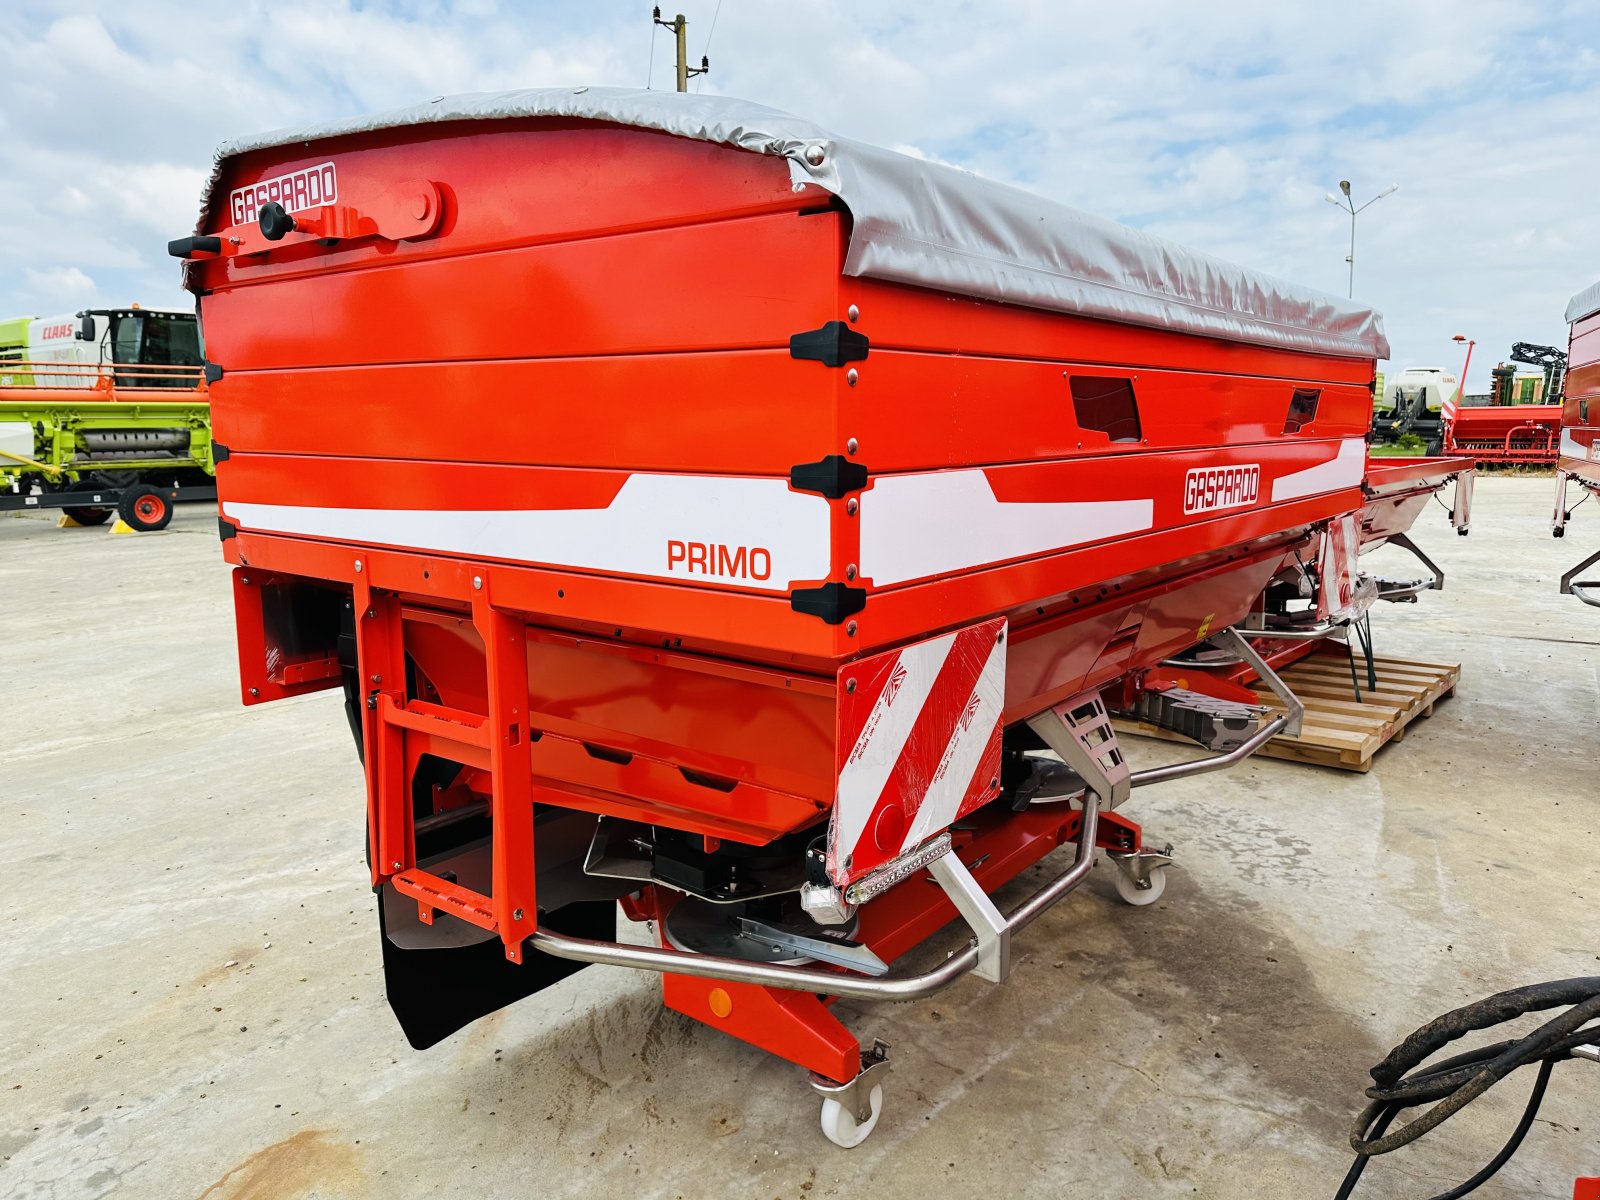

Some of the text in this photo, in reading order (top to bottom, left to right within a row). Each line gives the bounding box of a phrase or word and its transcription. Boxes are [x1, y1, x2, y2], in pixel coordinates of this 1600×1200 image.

[231, 164, 336, 226] GASPARDO
[43, 323, 73, 340] CLAAS
[1185, 467, 1259, 511] GASPARDO
[667, 539, 771, 581] PRIMO
